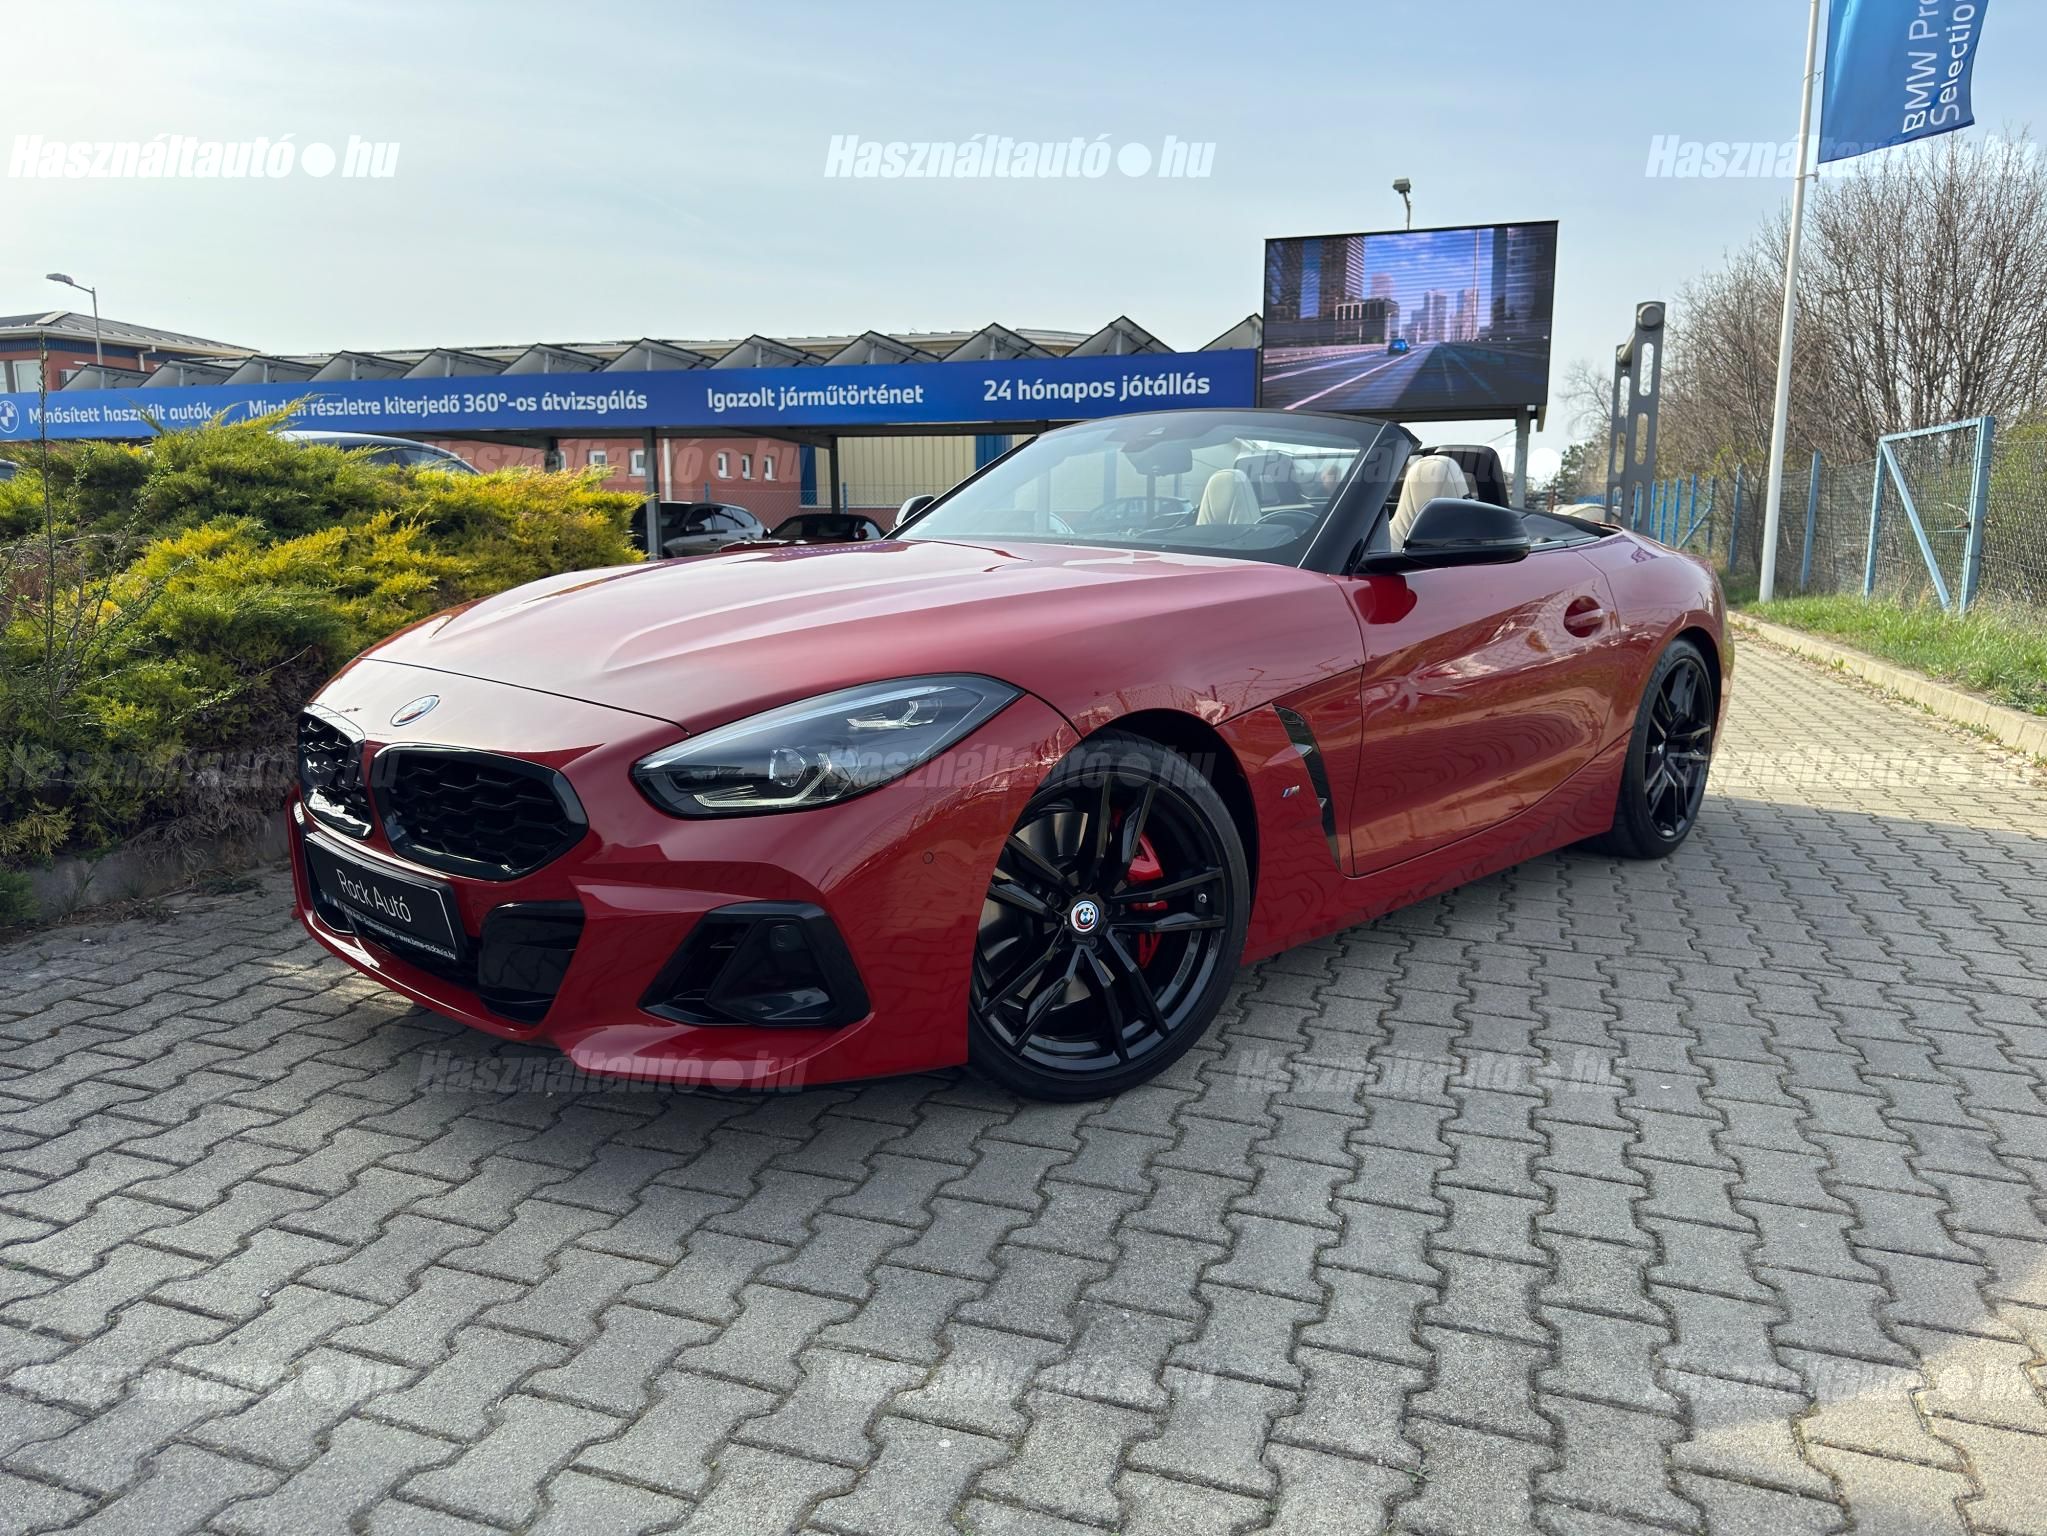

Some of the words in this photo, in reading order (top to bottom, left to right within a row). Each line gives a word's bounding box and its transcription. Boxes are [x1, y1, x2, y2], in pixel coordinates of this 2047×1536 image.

[1930, 0, 1975, 125] Selectio
[1902, 51, 1937, 133] BMW
[707, 386, 775, 413] Igazolt
[778, 384, 924, 411] járműtörténet
[983, 379, 1011, 401] 24
[1017, 378, 1116, 403] hónapos
[1119, 372, 1211, 402] jótállás
[28, 406, 100, 425] Mnősített
[169, 402, 213, 420] autók
[310, 398, 381, 416] részletre
[384, 393, 460, 418] kiterjedő
[541, 389, 648, 414] átvizsgálás
[335, 868, 374, 908] Rock
[373, 886, 412, 923] Autó
